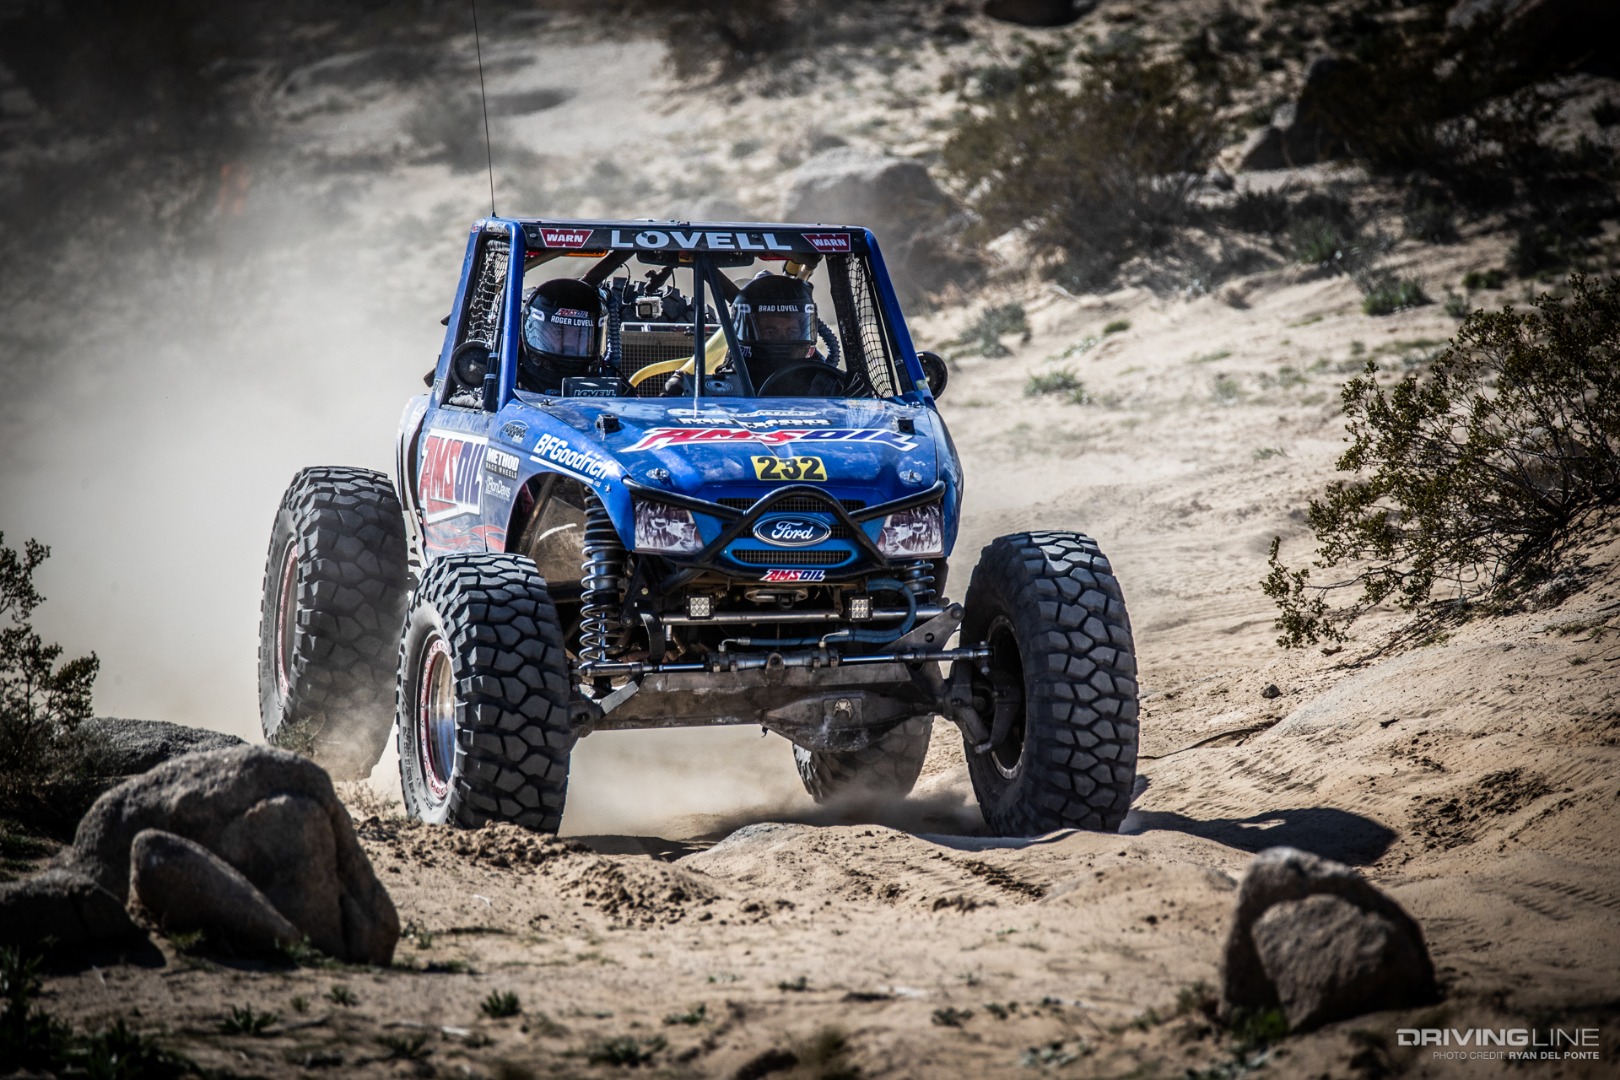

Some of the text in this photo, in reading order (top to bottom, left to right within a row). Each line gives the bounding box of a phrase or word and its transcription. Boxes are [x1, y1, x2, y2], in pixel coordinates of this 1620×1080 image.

[546, 233, 583, 243] WARN
[611, 230, 793, 250] LOVELL
[812, 238, 847, 247] WARN
[758, 304, 799, 312] BRAD LOVELL
[551, 315, 595, 327] ROGER LOVELL
[574, 389, 617, 398] LOVELL
[622, 428, 917, 451] AMSOIL
[486, 447, 520, 472] METHOD
[533, 433, 612, 480] BFGoodrich
[420, 434, 487, 514] AMSOIL
[485, 462, 518, 480] RACE WHEELS
[757, 456, 824, 480] 232
[771, 521, 814, 539] Ford
[761, 569, 825, 581] AMSOIL
